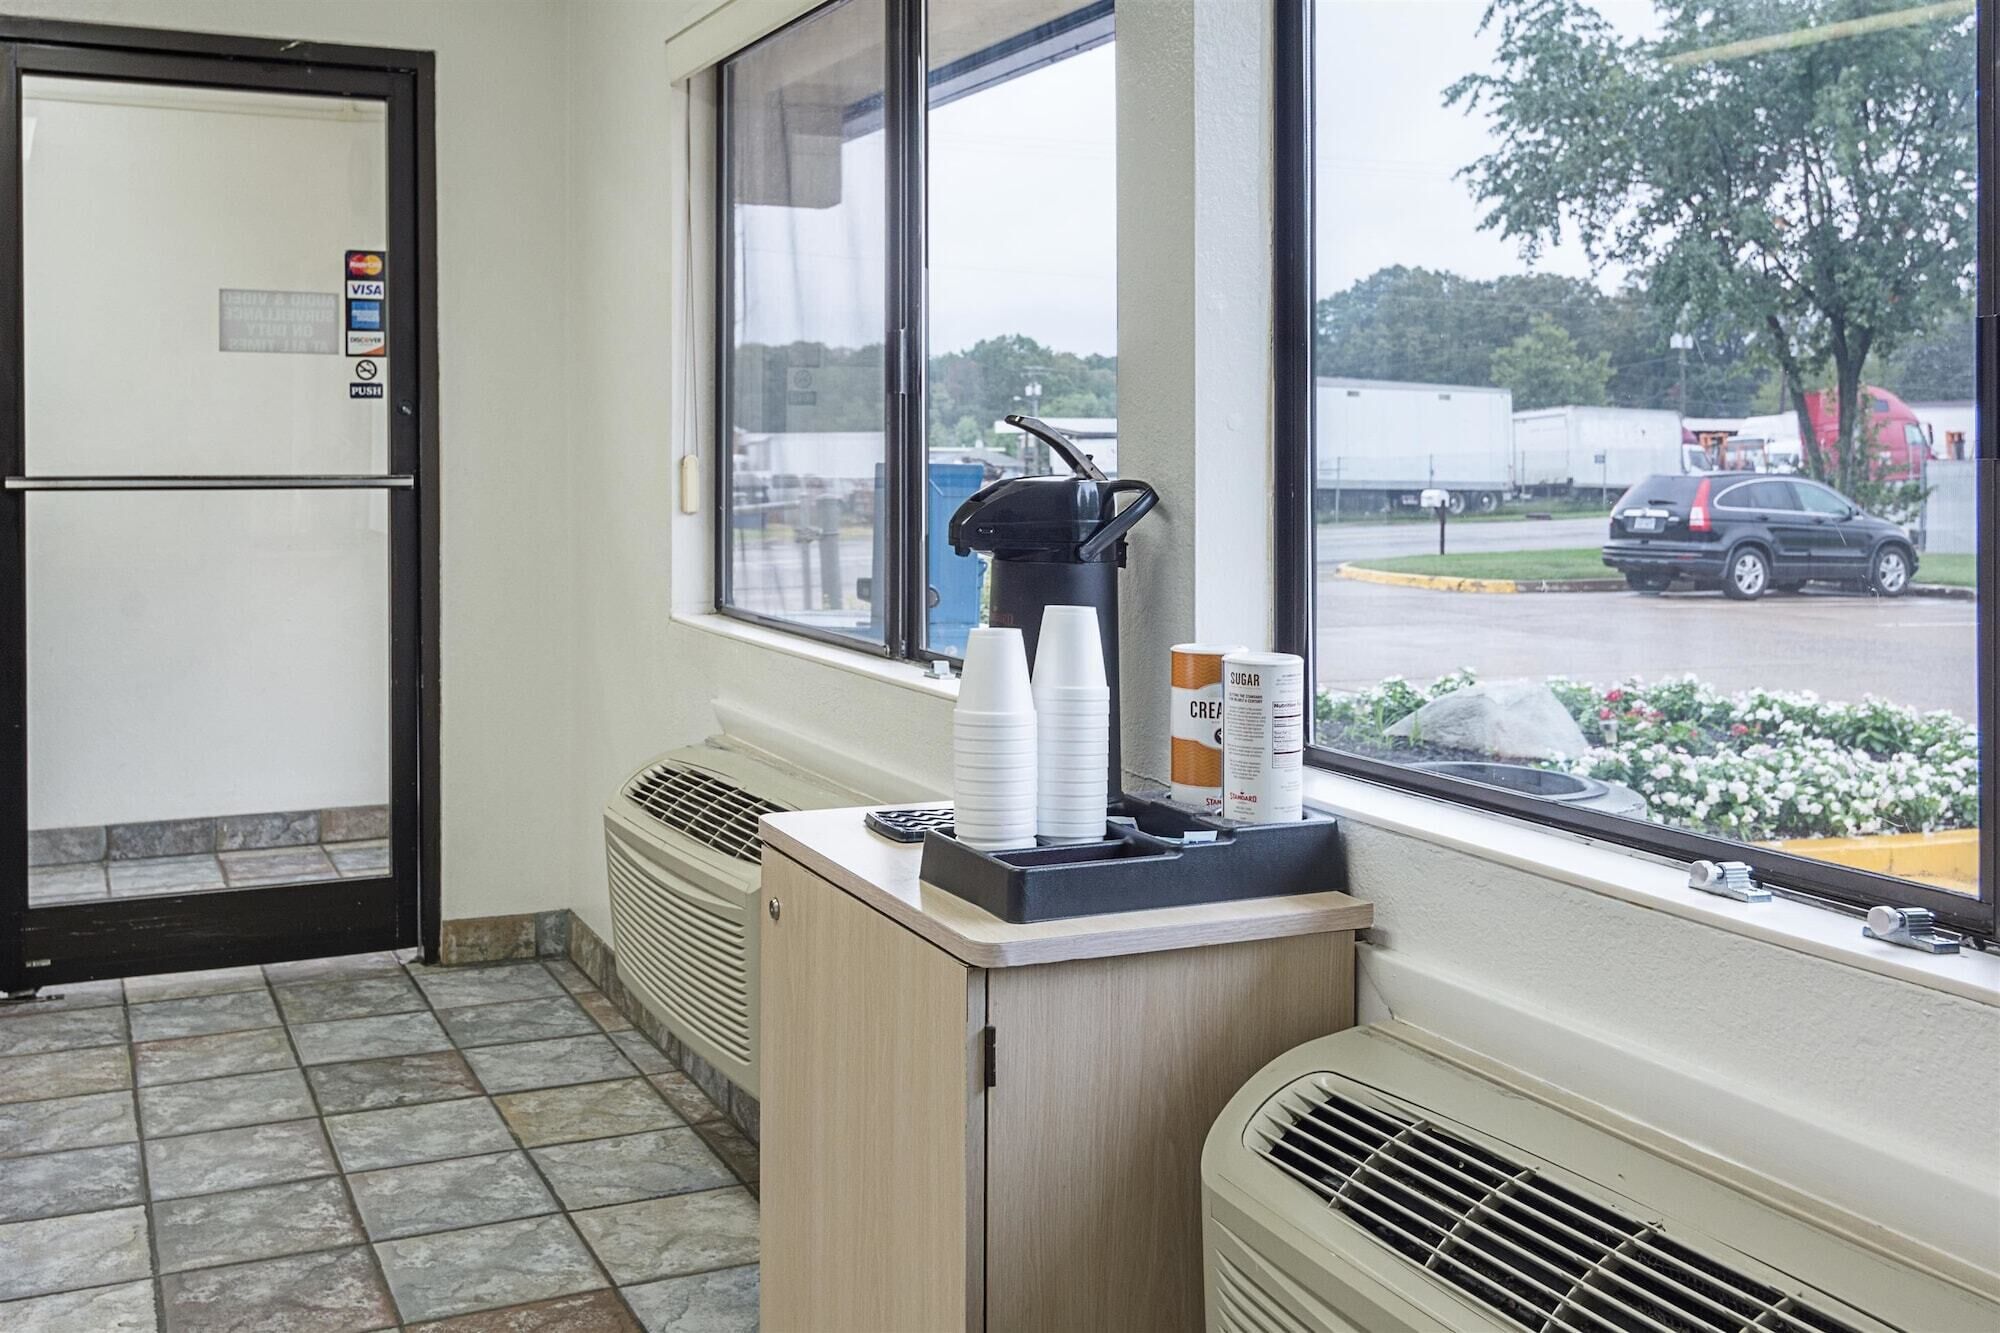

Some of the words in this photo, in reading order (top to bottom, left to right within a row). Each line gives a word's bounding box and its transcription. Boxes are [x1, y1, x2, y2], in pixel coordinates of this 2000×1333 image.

[352, 284, 382, 295] VISA
[350, 336, 382, 344] DISCOVER
[351, 385, 382, 397] PUSH
[1230, 671, 1260, 687] SUGAR
[1230, 792, 1257, 803] STANDARD
